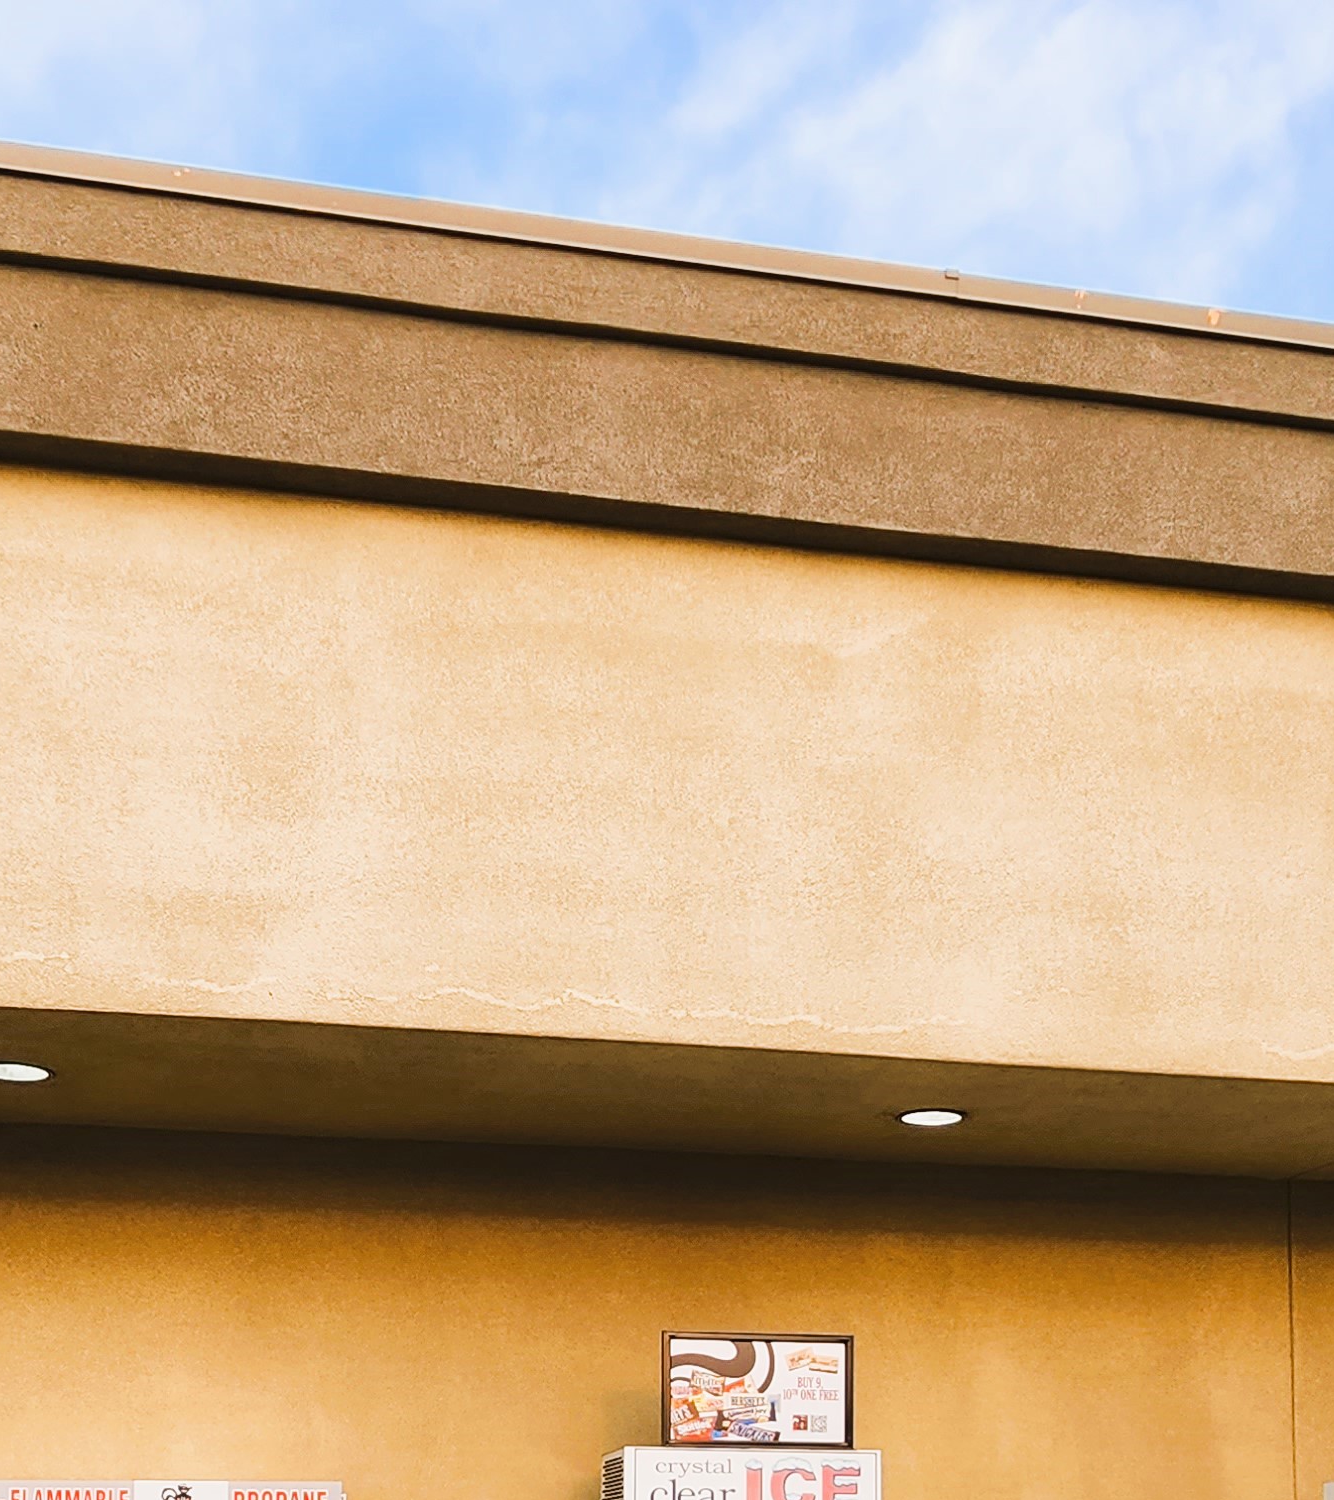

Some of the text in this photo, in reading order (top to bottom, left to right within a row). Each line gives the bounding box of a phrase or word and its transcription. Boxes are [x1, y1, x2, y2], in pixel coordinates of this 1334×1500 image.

[797, 1376, 814, 1388] BUY
[800, 1389, 817, 1400] ONE
[819, 1389, 840, 1401] FREE
[655, 1458, 732, 1478] crystal
